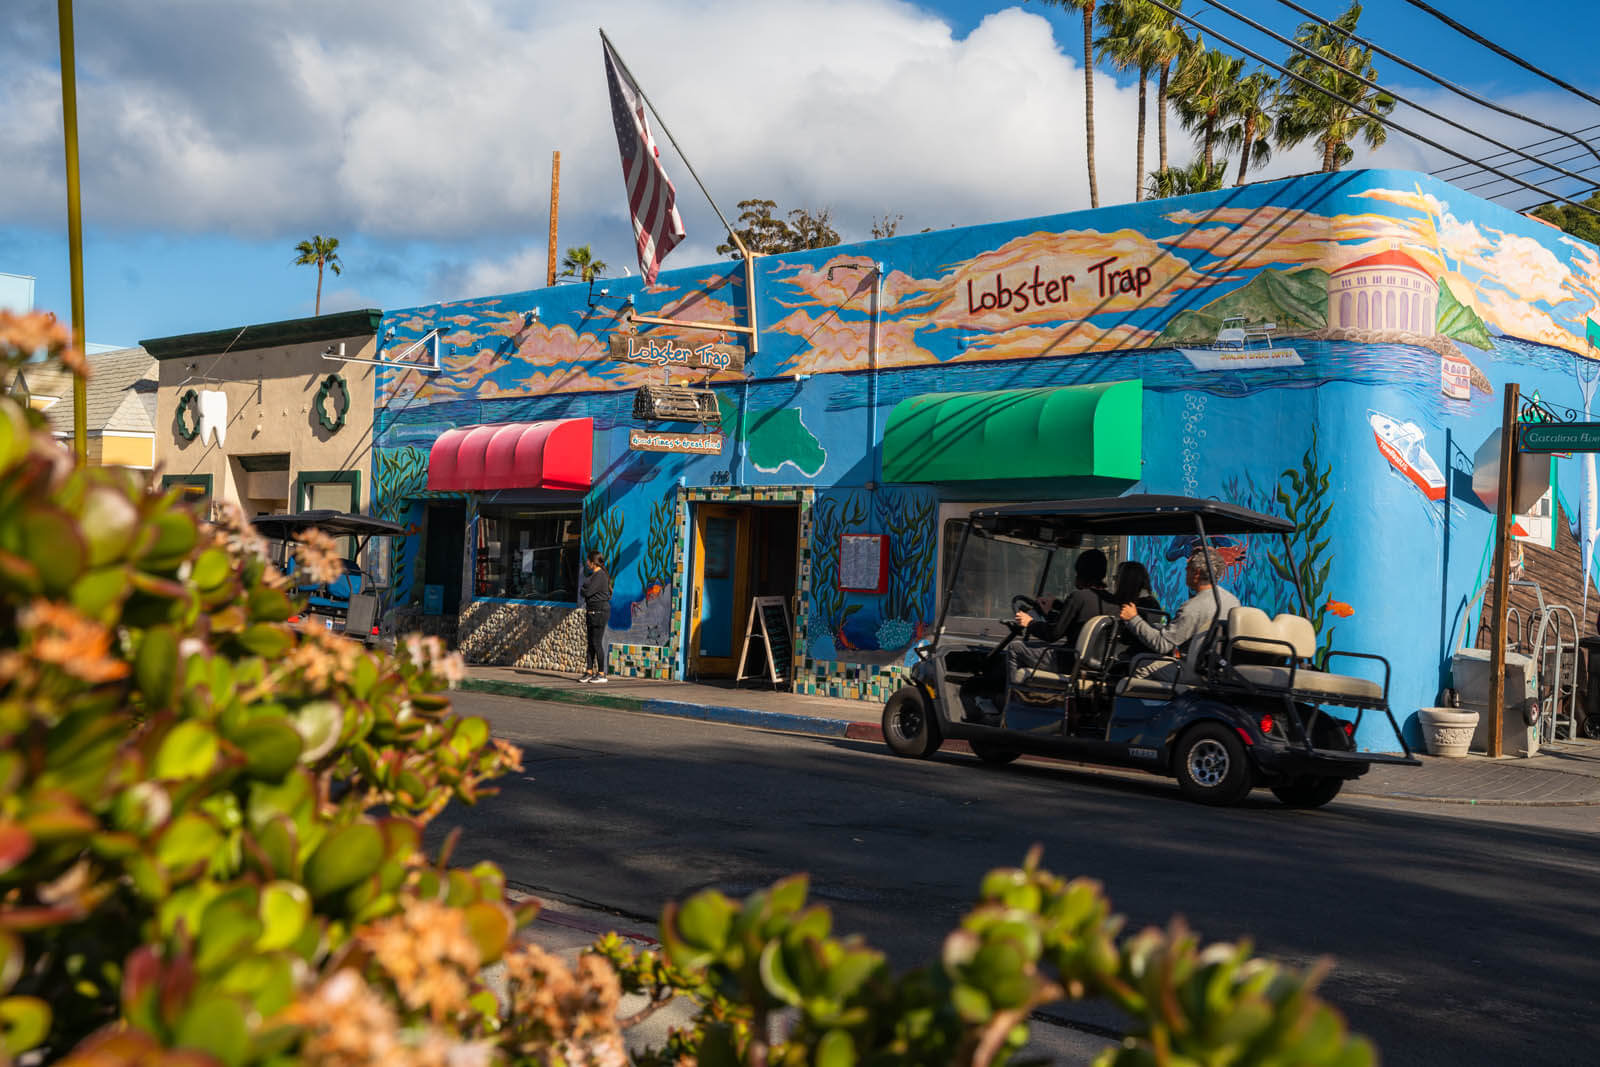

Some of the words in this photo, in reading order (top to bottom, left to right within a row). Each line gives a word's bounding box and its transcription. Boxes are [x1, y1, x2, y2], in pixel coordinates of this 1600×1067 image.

[967, 265, 1074, 314] Lobster
[1088, 256, 1150, 297] Trap
[627, 337, 692, 366] Lobster
[695, 343, 731, 370] Trap
[632, 434, 652, 445] Good
[652, 436, 673, 448] Times
[682, 438, 703, 448] Great
[703, 440, 721, 450] Food
[1529, 432, 1577, 443] Catalina
